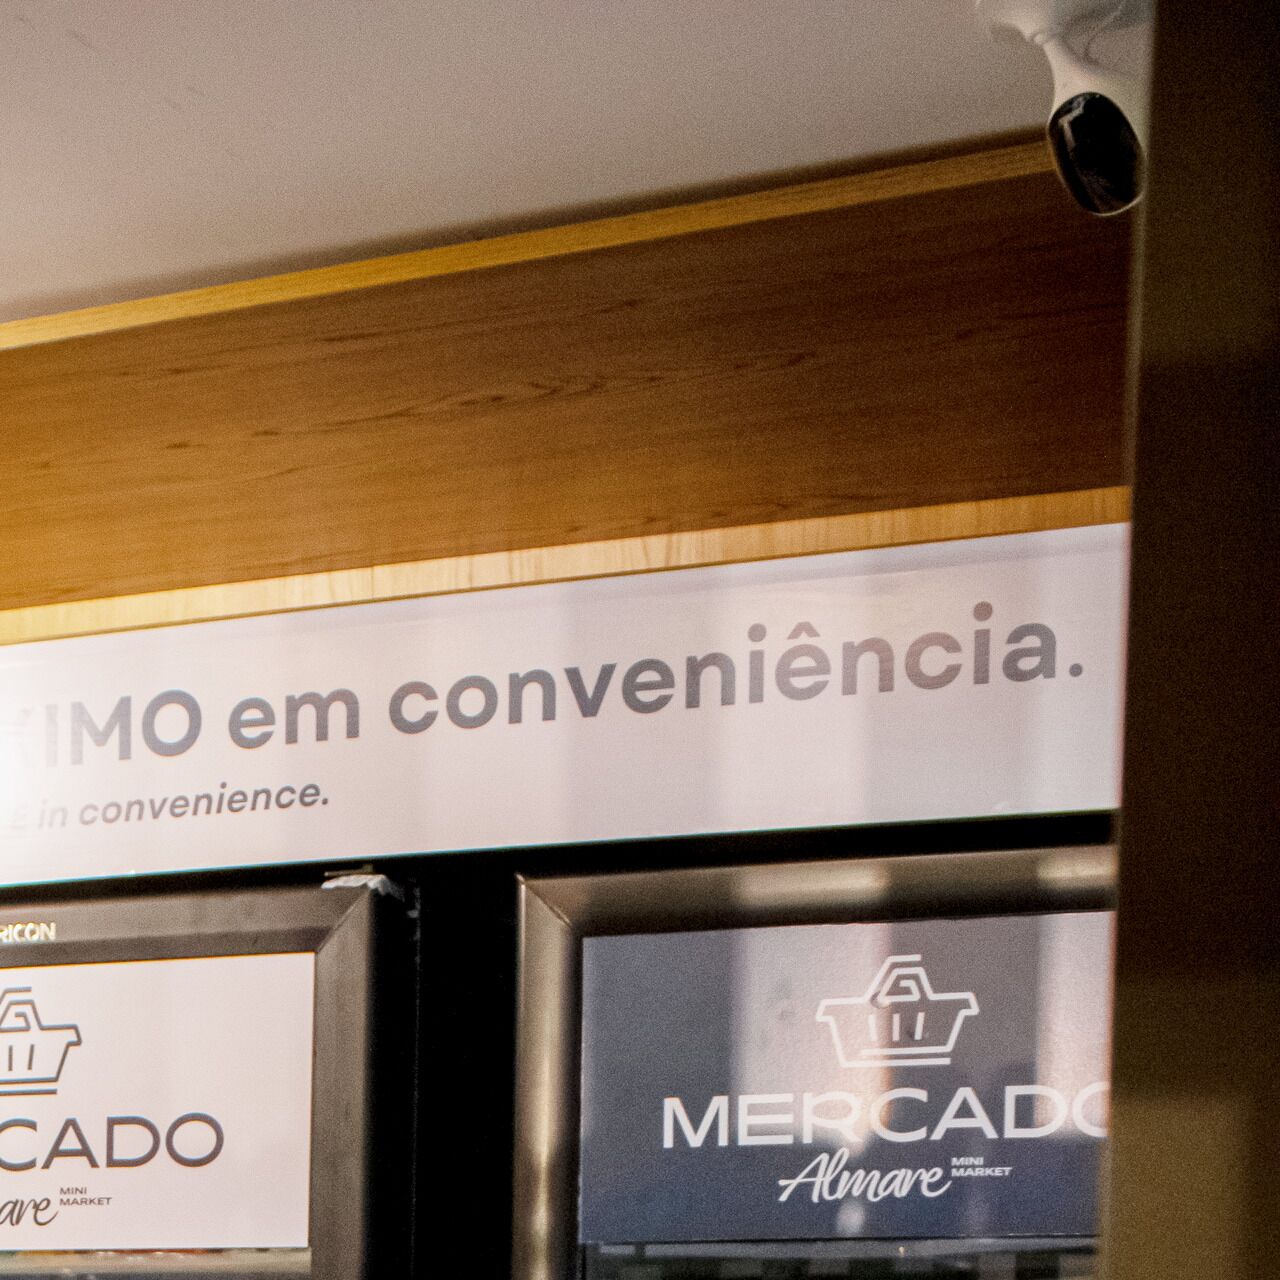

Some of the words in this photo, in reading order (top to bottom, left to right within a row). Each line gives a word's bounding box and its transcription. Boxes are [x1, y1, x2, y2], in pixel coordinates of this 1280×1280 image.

[42, 687, 203, 769] IMO
[228, 687, 361, 750] em
[387, 601, 1086, 737] conveniência.
[37, 798, 68, 830] in
[78, 782, 329, 826] convenience.
[951, 1156, 985, 1166] MINI
[778, 1147, 954, 1204] Almare
[951, 1166, 1013, 1177] MARKET
[59, 1186, 89, 1196] MINI
[59, 1196, 113, 1207] MARKET
